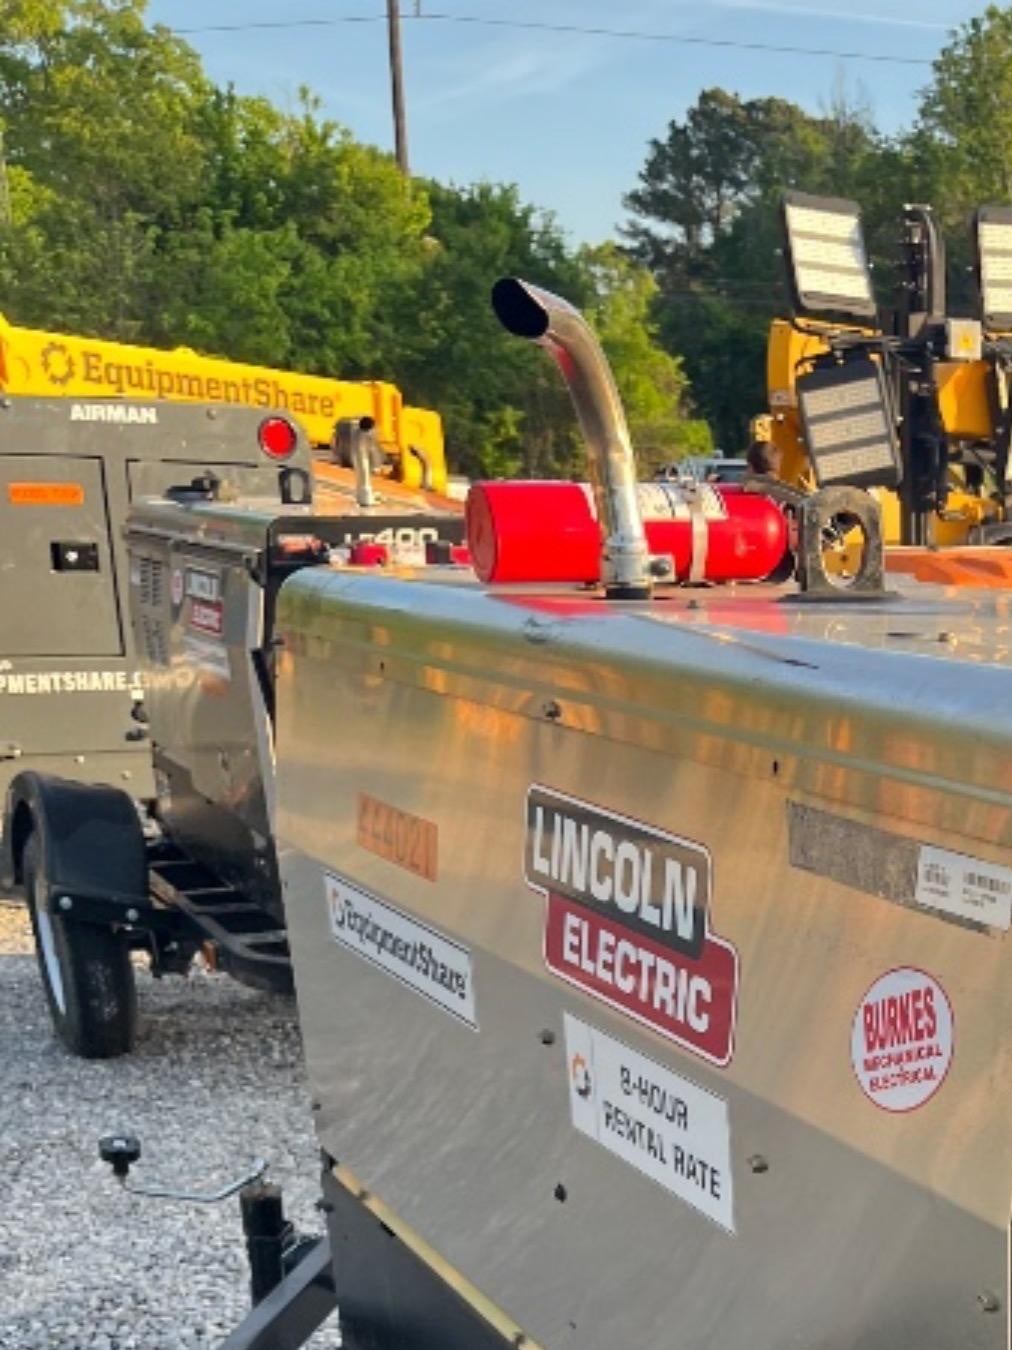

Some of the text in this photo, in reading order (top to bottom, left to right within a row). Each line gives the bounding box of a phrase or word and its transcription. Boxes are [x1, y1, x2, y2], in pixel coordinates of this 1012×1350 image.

[69, 403, 157, 423] AIRMAN
[82, 350, 336, 416] EquipmentShare
[532, 805, 698, 941] LINCOLN
[563, 911, 713, 1034] ELECTRIC
[862, 986, 937, 1053] BURKES
[603, 1100, 722, 1201] RENTAL RATE
